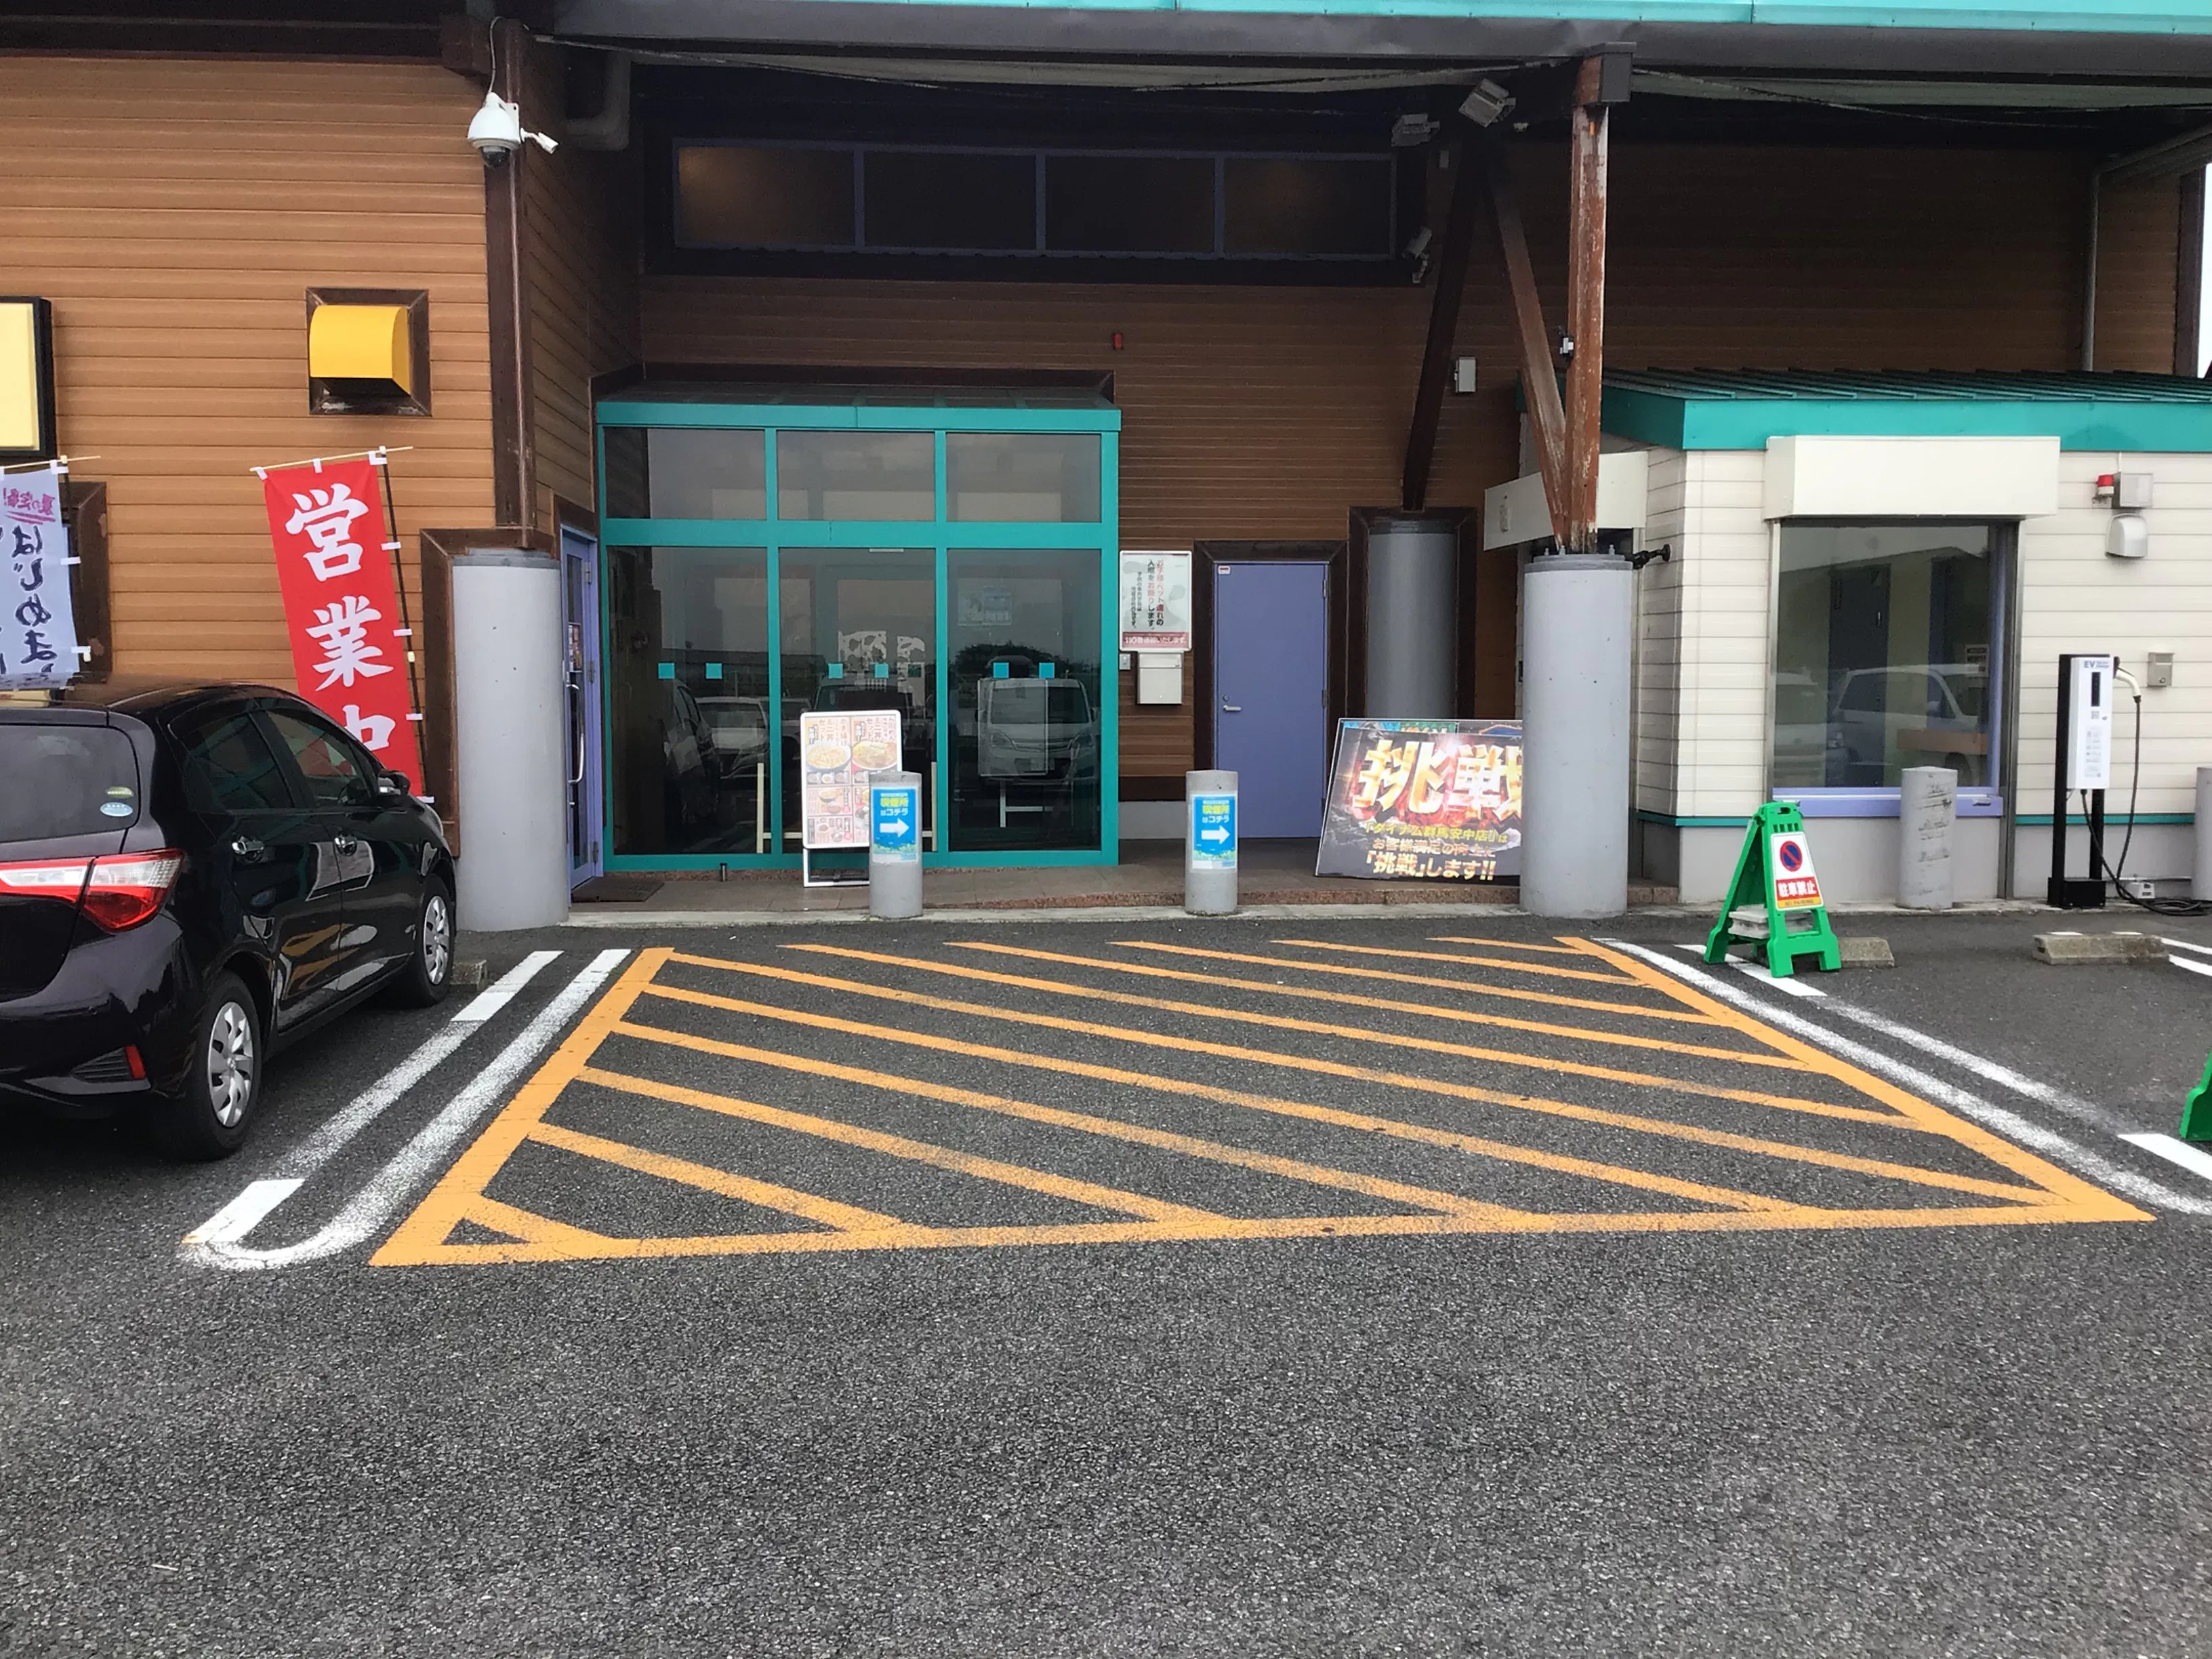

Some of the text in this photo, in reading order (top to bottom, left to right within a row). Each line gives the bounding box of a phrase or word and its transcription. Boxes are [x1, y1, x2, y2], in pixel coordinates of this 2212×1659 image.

[2084, 660, 2096, 668] EV
[880, 807, 909, 816] はコチラ
[1202, 815, 1230, 823] はコチラ
[1372, 837, 1496, 858] お客様満足の向上に
[1778, 880, 1816, 897] 駐車禁止
